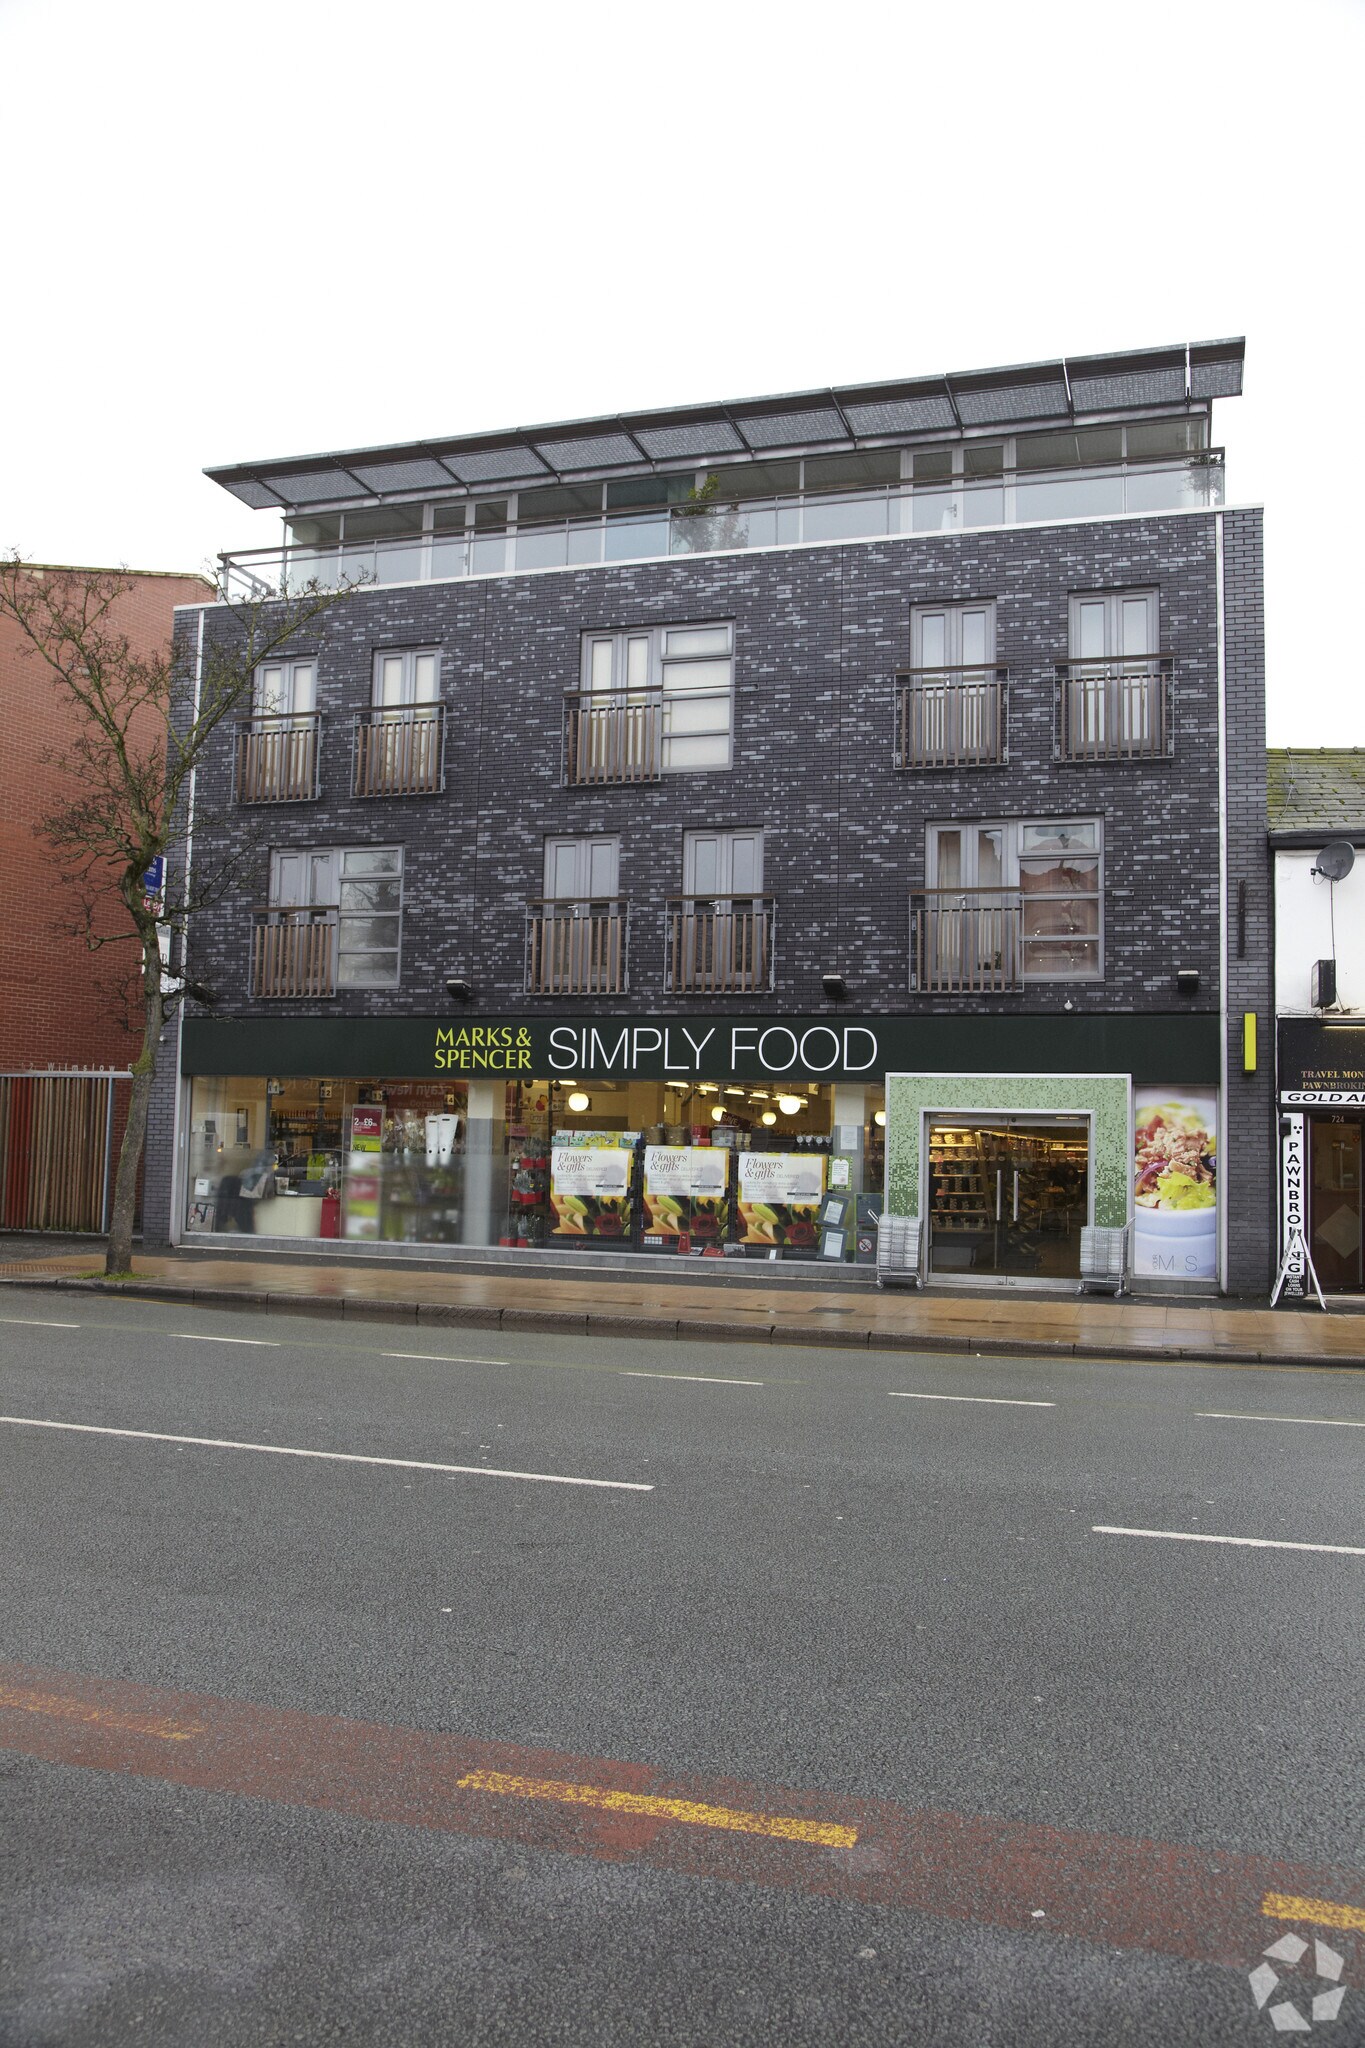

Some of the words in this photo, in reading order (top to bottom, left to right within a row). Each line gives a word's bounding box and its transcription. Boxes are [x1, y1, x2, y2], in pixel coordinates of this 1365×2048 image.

[435, 1026, 513, 1047] MARKS
[515, 1026, 532, 1047] &
[547, 1026, 716, 1071] SIMPLY
[731, 1026, 878, 1072] FOOD
[434, 1049, 533, 1070] SPENCER
[1301, 1070, 1340, 1078] TRAVEL
[1287, 1092, 1343, 1102] GOLD
[1346, 1093, 1365, 1103] A
[354, 1117, 360, 1126] 2
[1331, 1115, 1345, 1123] 724
[352, 1143, 367, 1151] NEW
[557, 1152, 593, 1163] Flowers
[651, 1151, 688, 1162] Flowers
[557, 1162, 566, 1171] &
[566, 1161, 586, 1173] gifts
[650, 1161, 659, 1171] &
[659, 1161, 680, 1173] gifts
[745, 1158, 784, 1169] Flowers
[744, 1168, 754, 1178] &
[754, 1168, 775, 1180] gifts
[1285, 1142, 1302, 1273] PAWNBRONG
